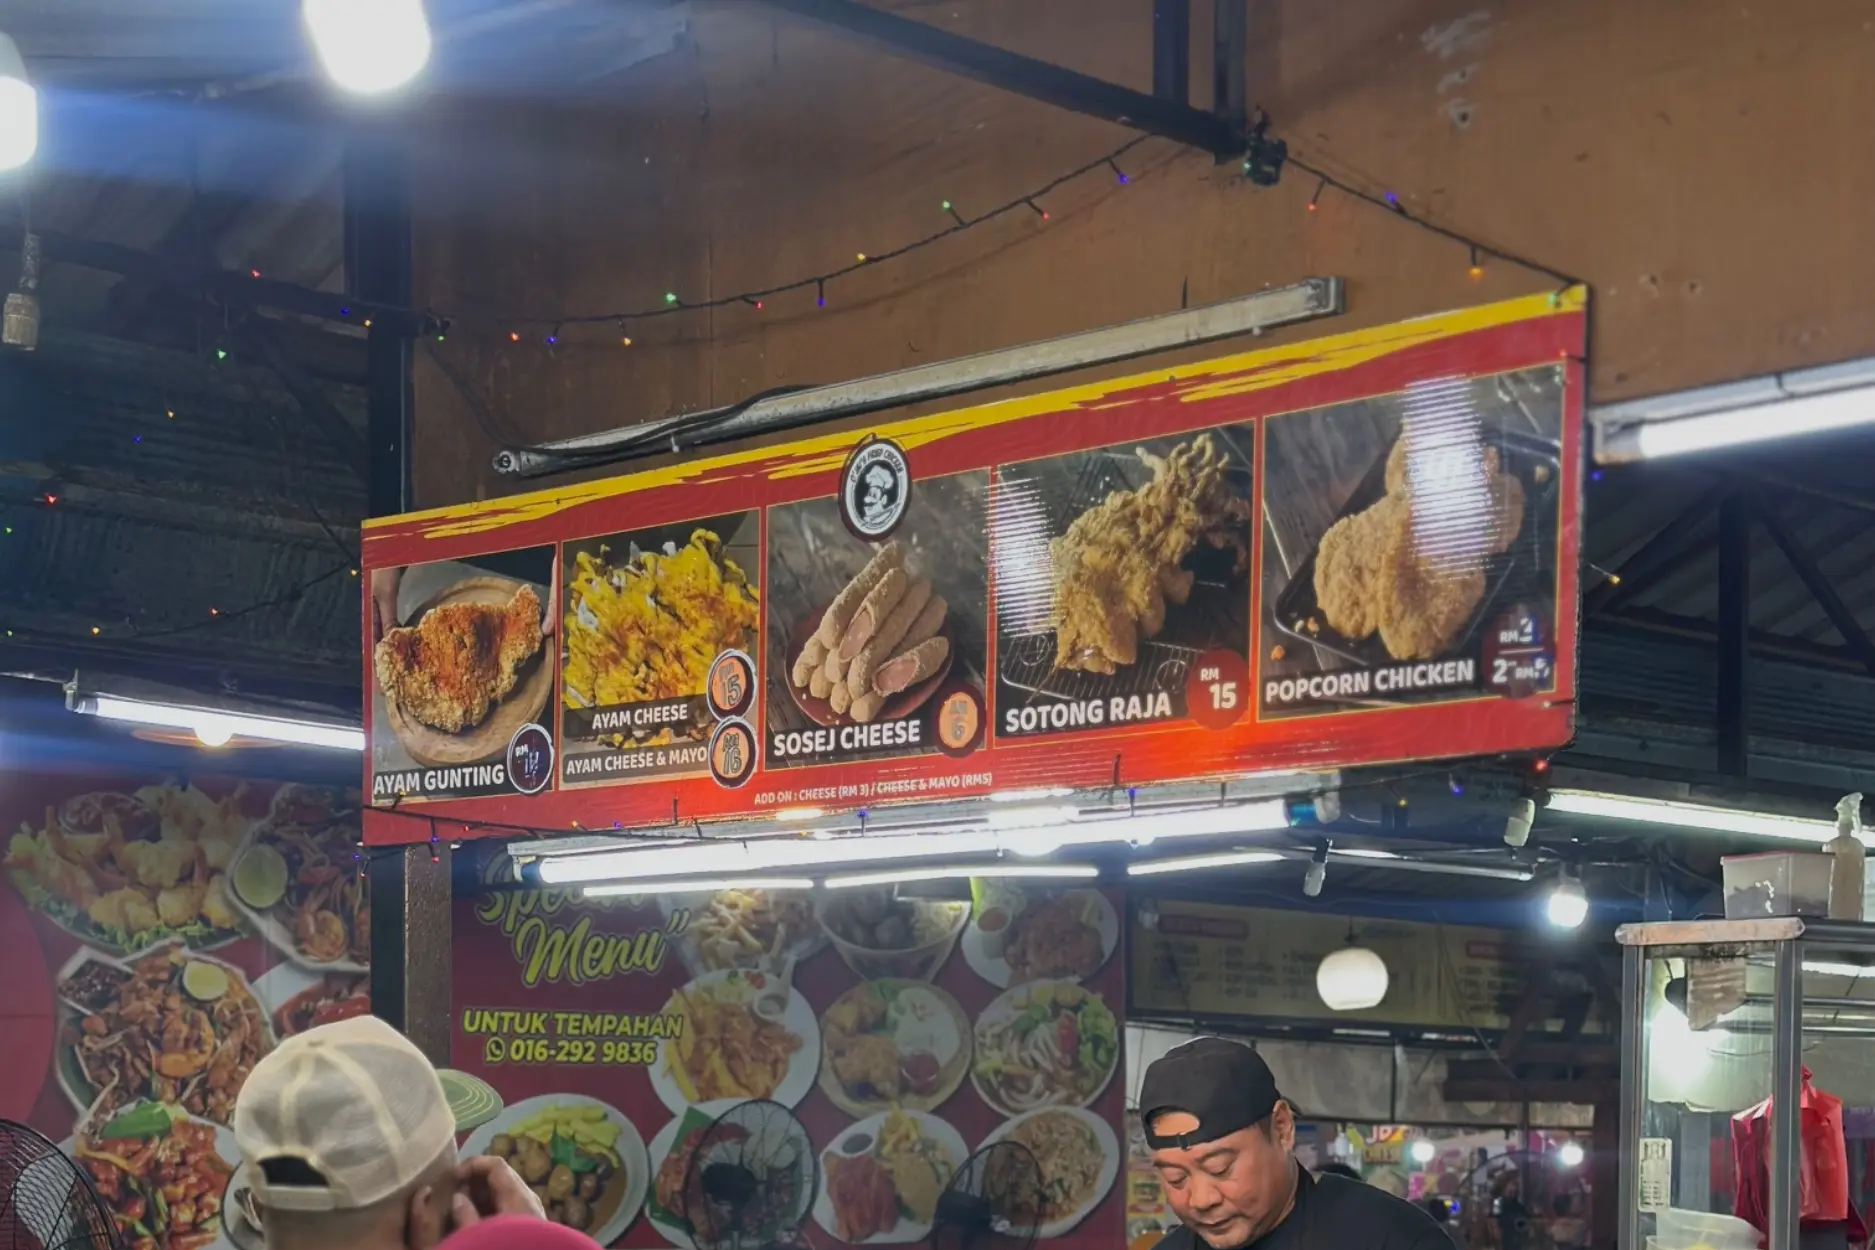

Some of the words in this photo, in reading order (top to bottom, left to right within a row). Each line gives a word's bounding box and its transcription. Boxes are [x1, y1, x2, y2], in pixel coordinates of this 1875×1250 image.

[1500, 630, 1518, 643] RM
[1201, 667, 1220, 682] RM
[1266, 670, 1369, 702] POPCORN
[1375, 659, 1475, 692] CHICKEN
[1209, 682, 1237, 710] 15
[592, 710, 631, 730] AYAM
[634, 703, 688, 725] CHEESE
[1005, 699, 1103, 733] SOTONG
[1110, 691, 1172, 722] RAJA
[774, 728, 834, 756] SOSEJ
[840, 719, 921, 749] CHEESE
[566, 758, 602, 775] AYAM
[604, 752, 654, 773] CHEESE
[656, 750, 667, 766] &
[669, 746, 708, 765] MAYO
[373, 771, 420, 795] AYAM
[424, 764, 504, 791] GUNTING
[754, 792, 775, 805] ADD
[777, 790, 792, 803] ON
[799, 787, 837, 801] CHEESE
[877, 779, 918, 794] CHEESE
[929, 775, 960, 790] MAYO
[463, 1008, 548, 1034] UNTUK
[554, 1012, 685, 1039] TEMPAHAN
[510, 1038, 597, 1063] 016-292
[602, 1040, 658, 1064] 9836
